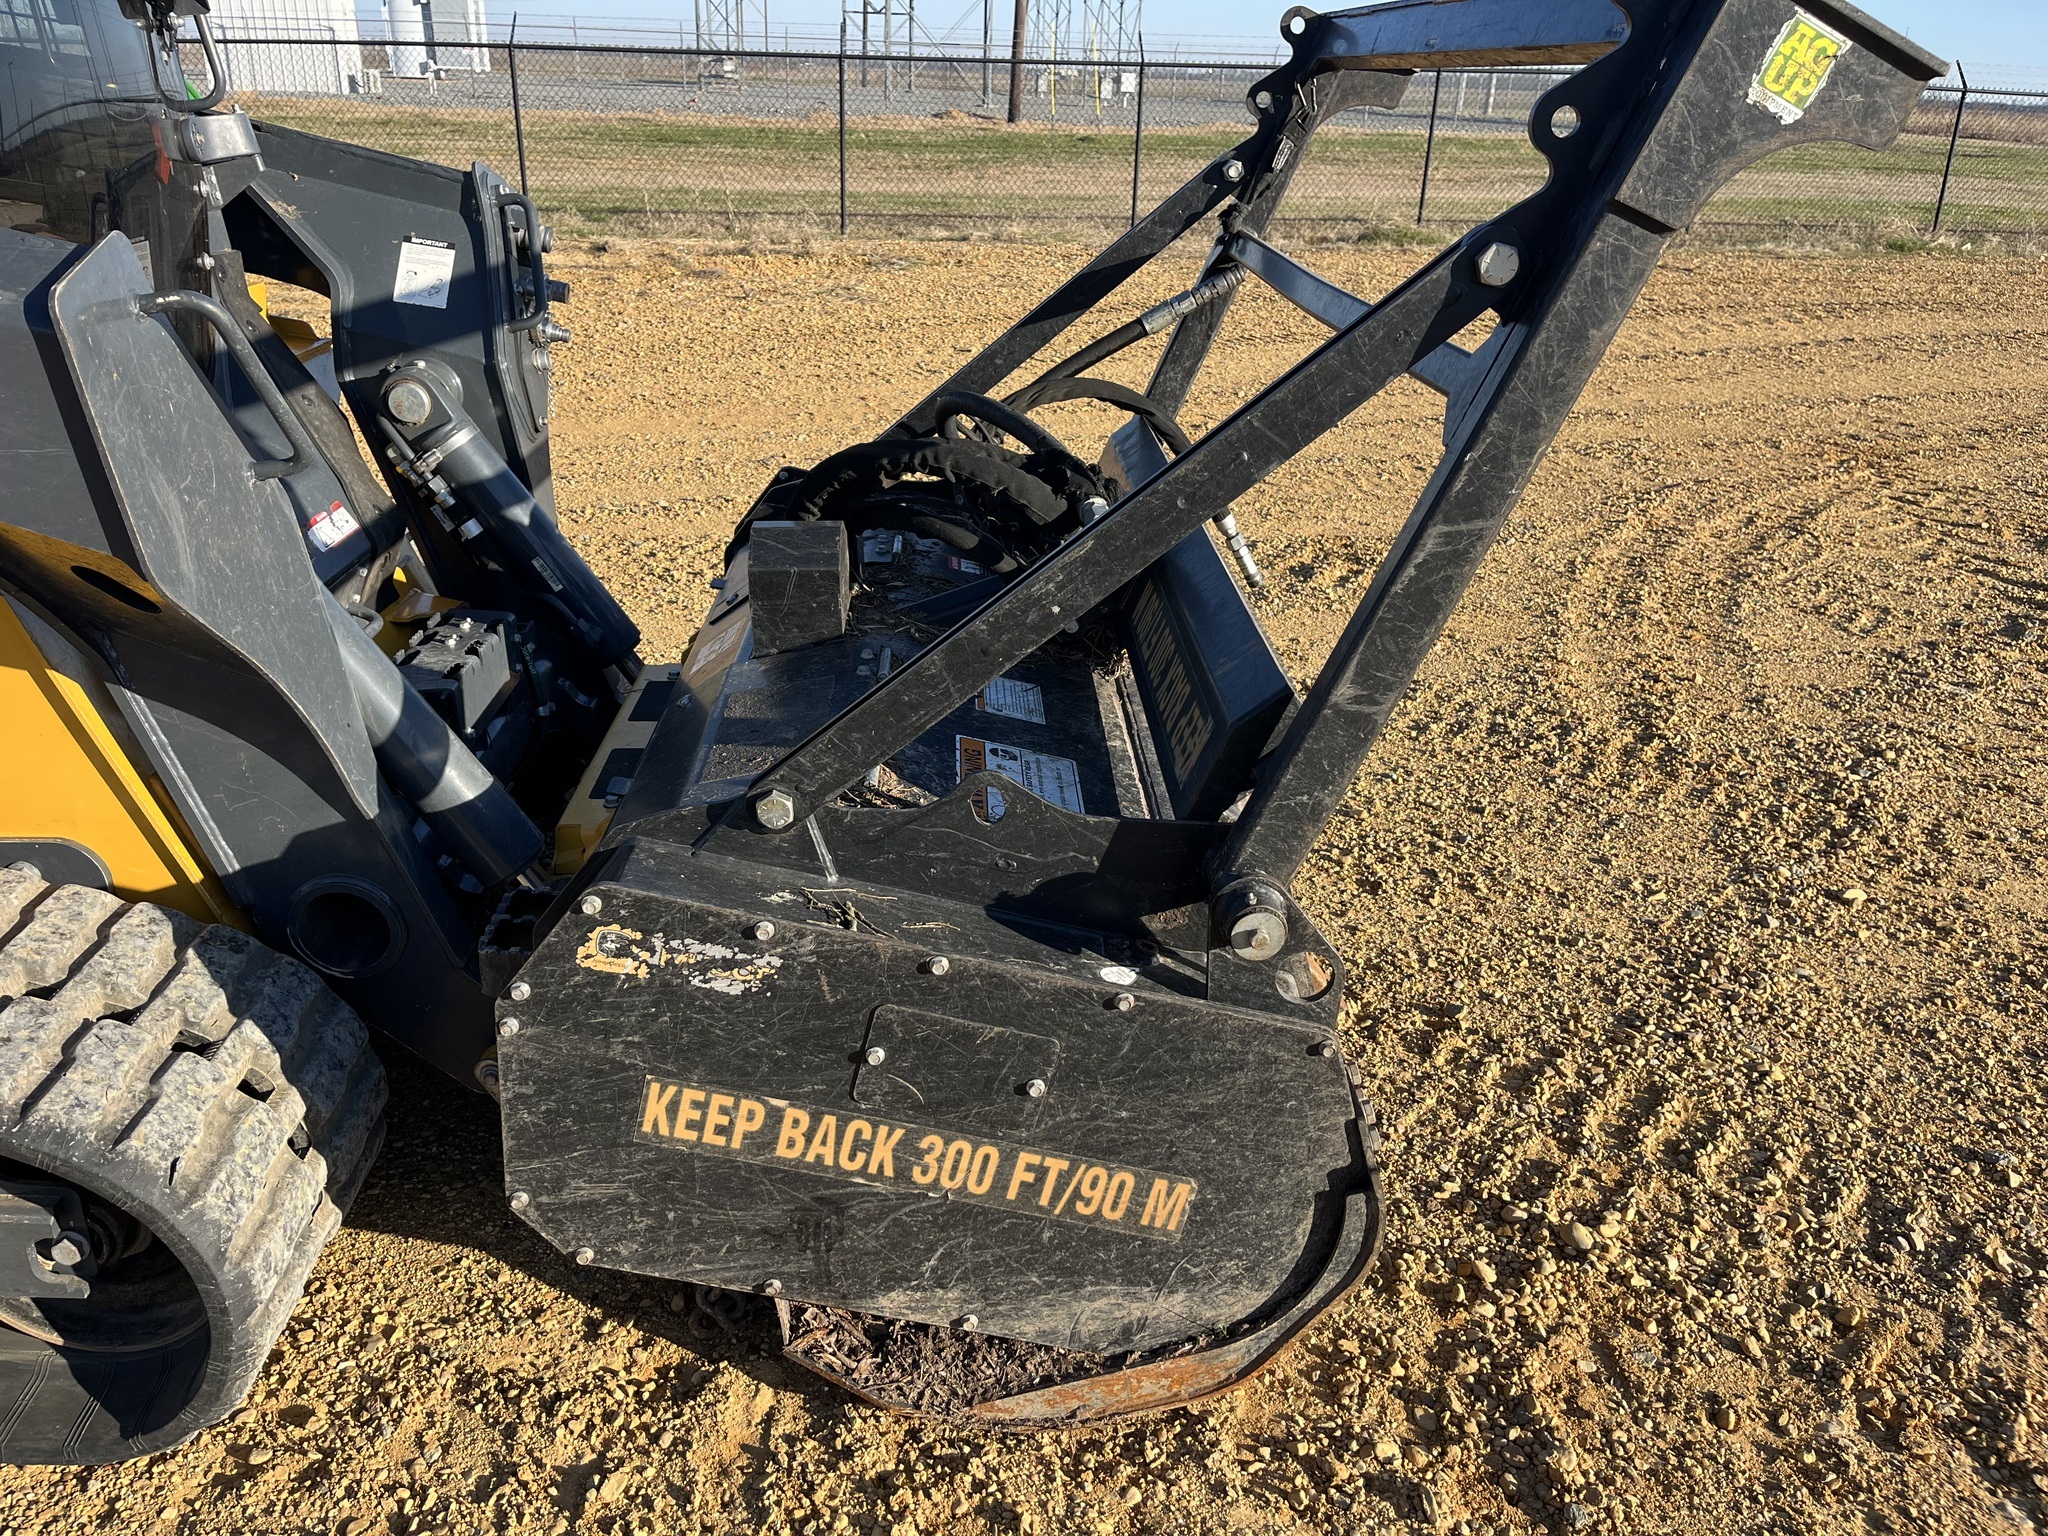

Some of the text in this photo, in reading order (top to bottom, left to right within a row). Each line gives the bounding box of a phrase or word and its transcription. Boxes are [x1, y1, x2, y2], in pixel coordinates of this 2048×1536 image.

[1764, 55, 1817, 104] UP
[411, 237, 449, 248] IMPORTANT
[1155, 652, 1191, 734] BACK
[641, 1082, 1192, 1231] KEEP BACK 300 FT/90 M
